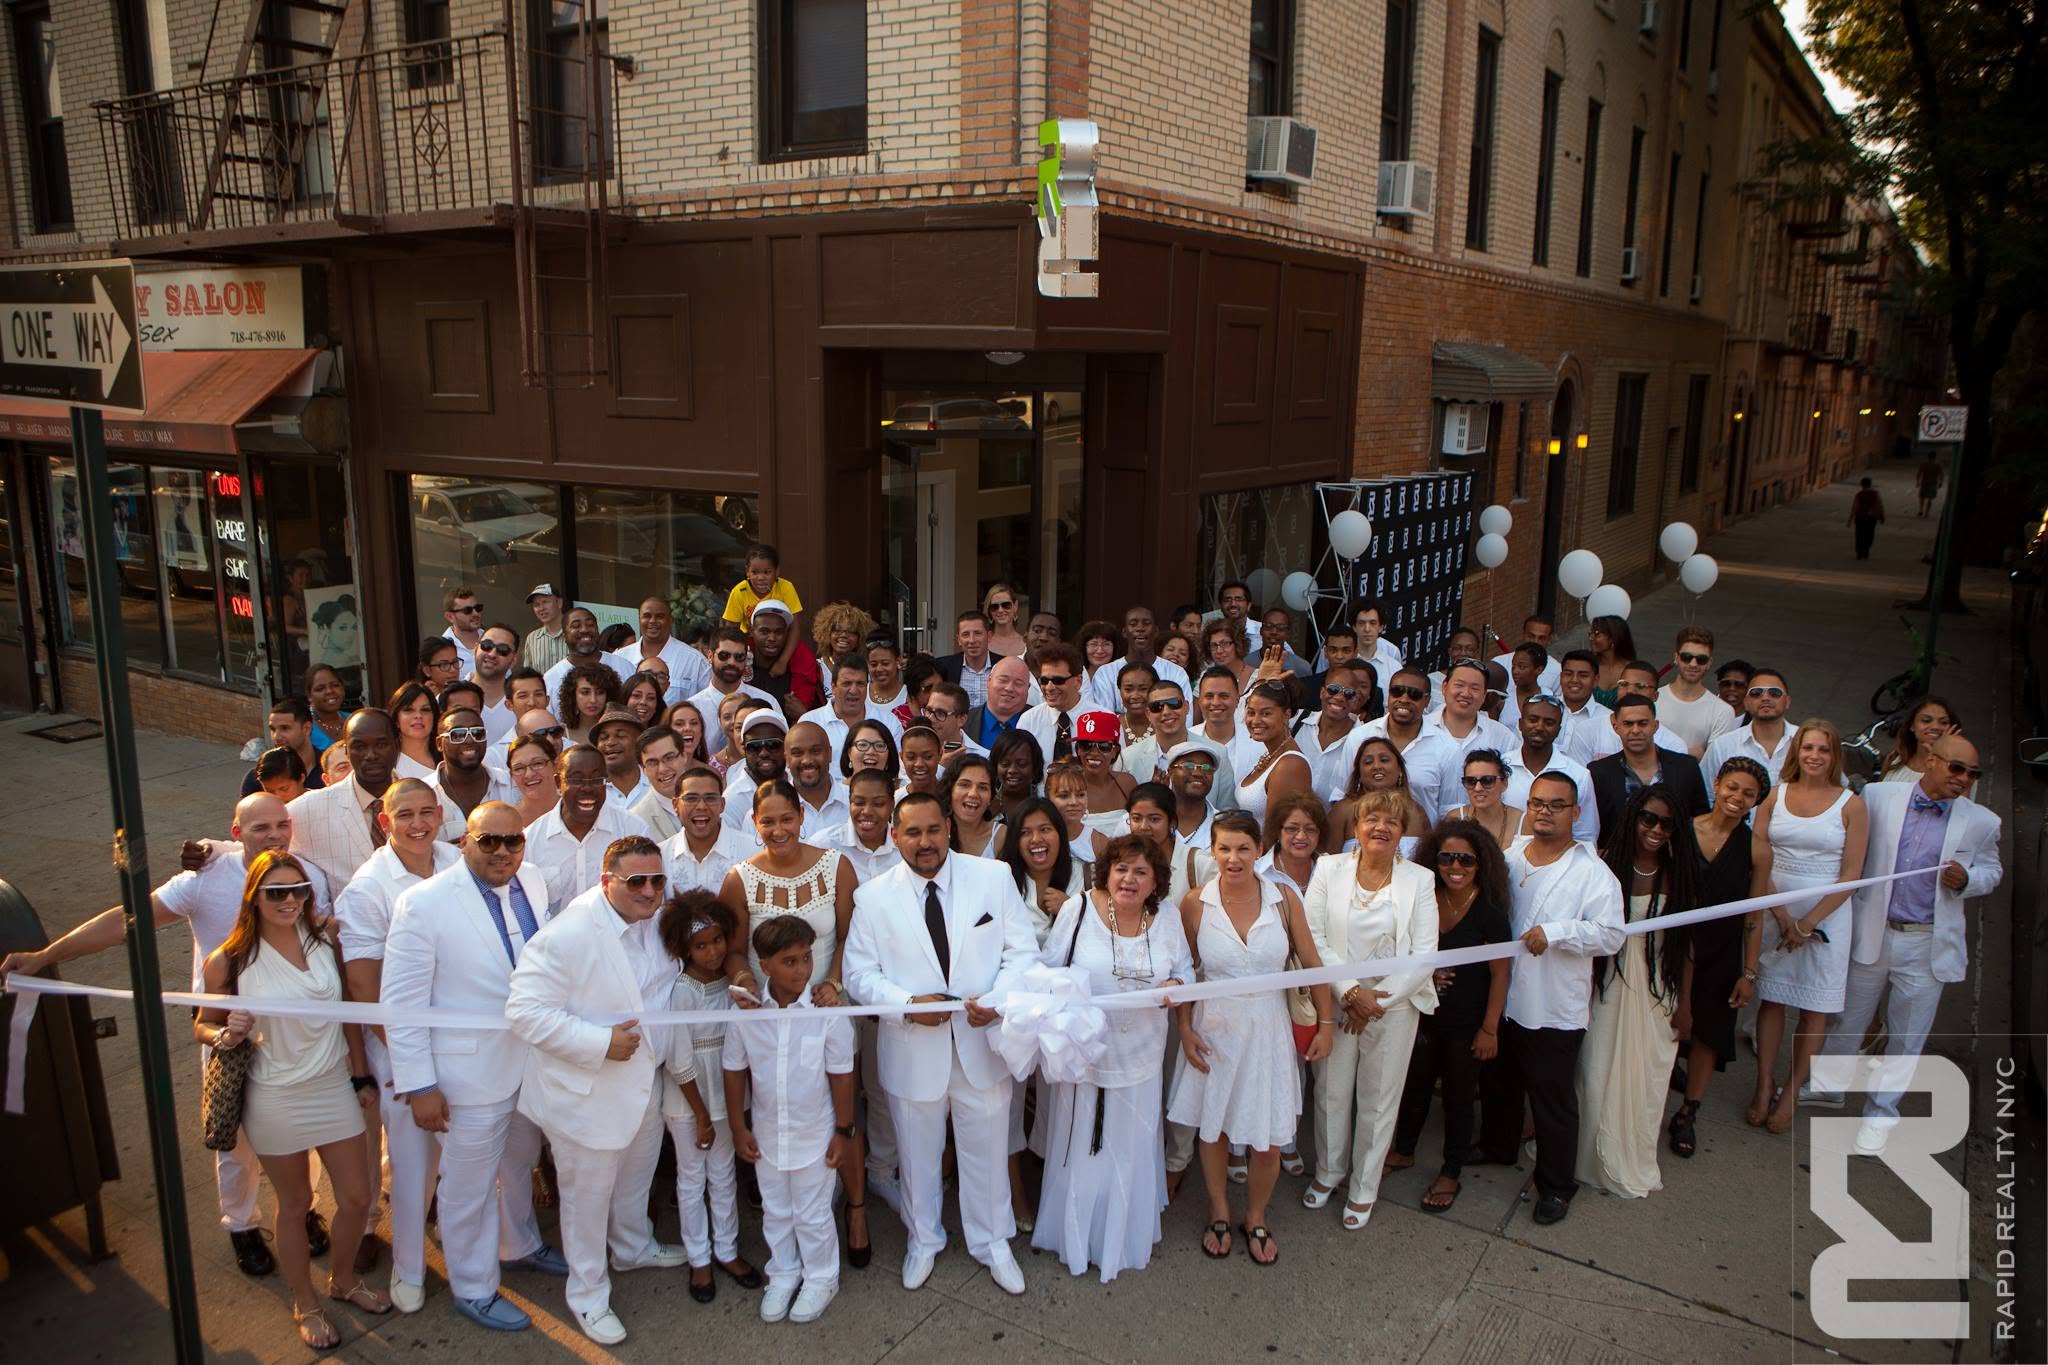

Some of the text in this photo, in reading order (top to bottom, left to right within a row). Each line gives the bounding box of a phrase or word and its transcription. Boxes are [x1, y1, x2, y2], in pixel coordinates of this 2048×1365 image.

[165, 279, 266, 317] SALON
[12, 310, 114, 364] ONE WAY
[230, 331, 286, 343] 718-476-8916
[133, 429, 154, 442] BODY
[155, 430, 174, 443] WAX
